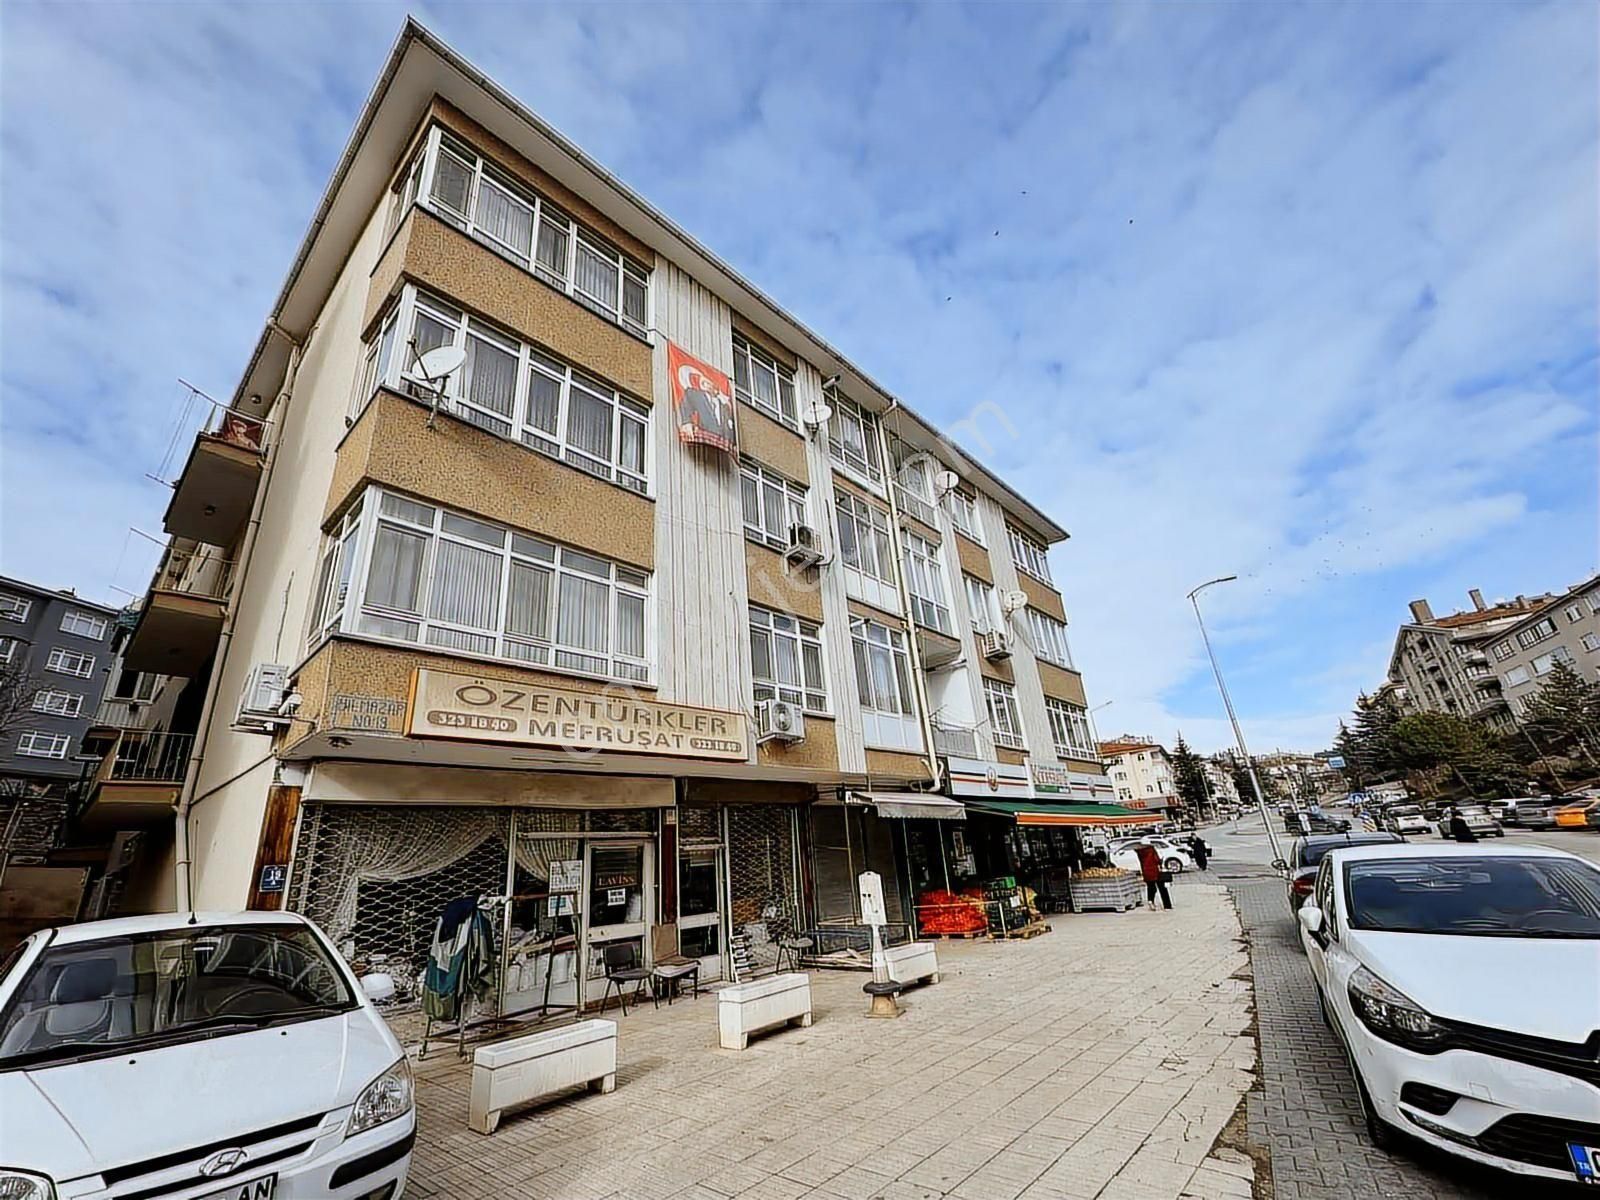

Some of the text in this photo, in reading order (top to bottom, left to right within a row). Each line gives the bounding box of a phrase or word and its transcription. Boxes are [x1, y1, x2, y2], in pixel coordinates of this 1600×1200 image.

[438, 713, 465, 726] 323
[455, 680, 726, 734] ÖZENTÜRKLER
[529, 719, 684, 750] MEFRUŞAT
